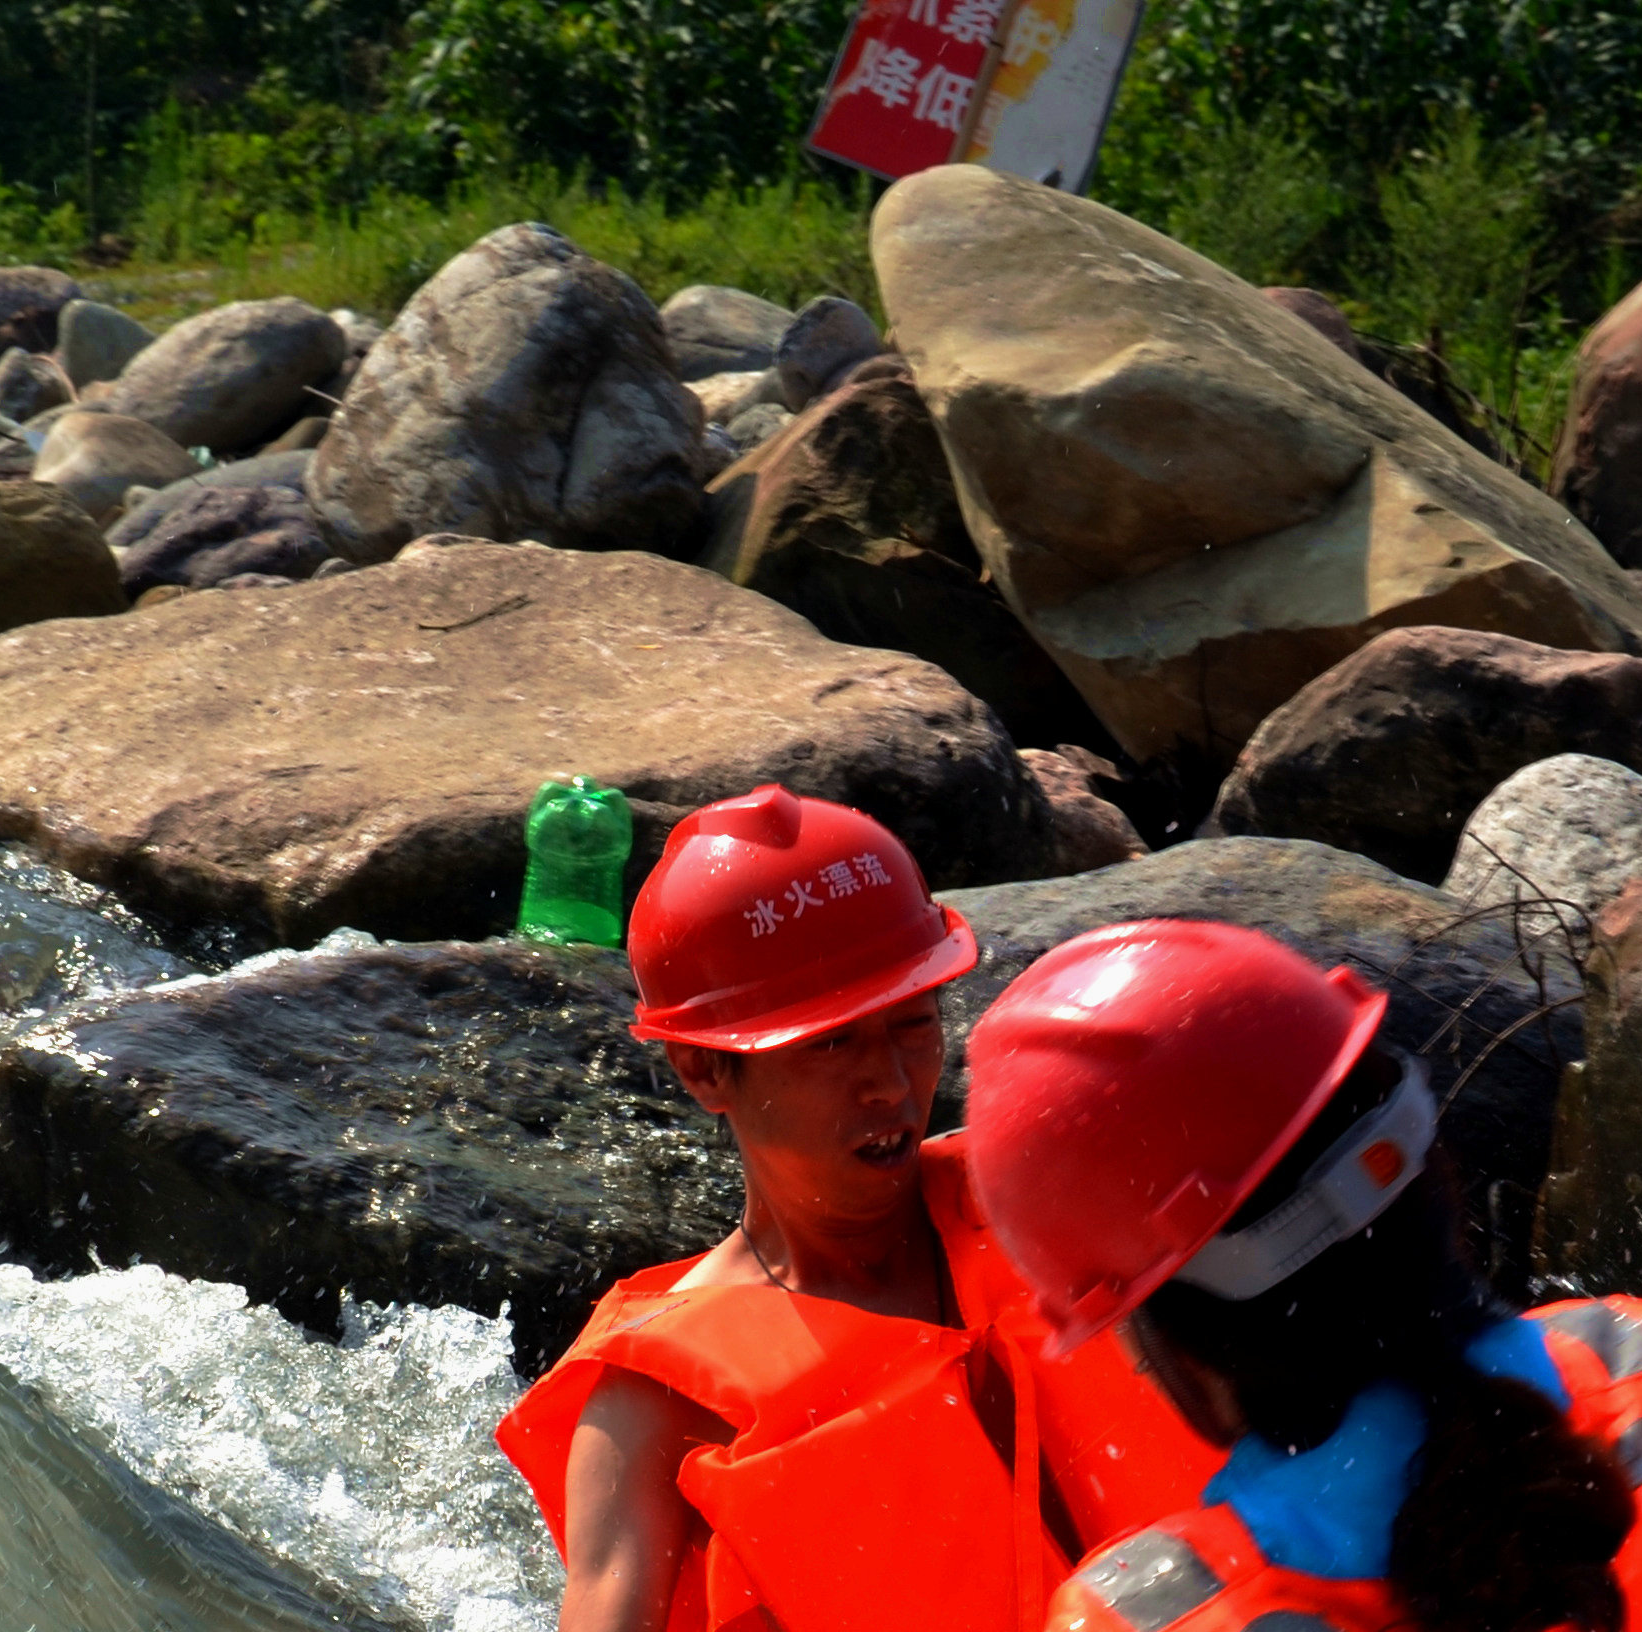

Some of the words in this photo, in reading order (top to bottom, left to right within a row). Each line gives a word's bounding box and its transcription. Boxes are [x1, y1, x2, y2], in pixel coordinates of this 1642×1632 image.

[847, 37, 979, 133] 降低
[743, 852, 892, 938] 冰火漂流
